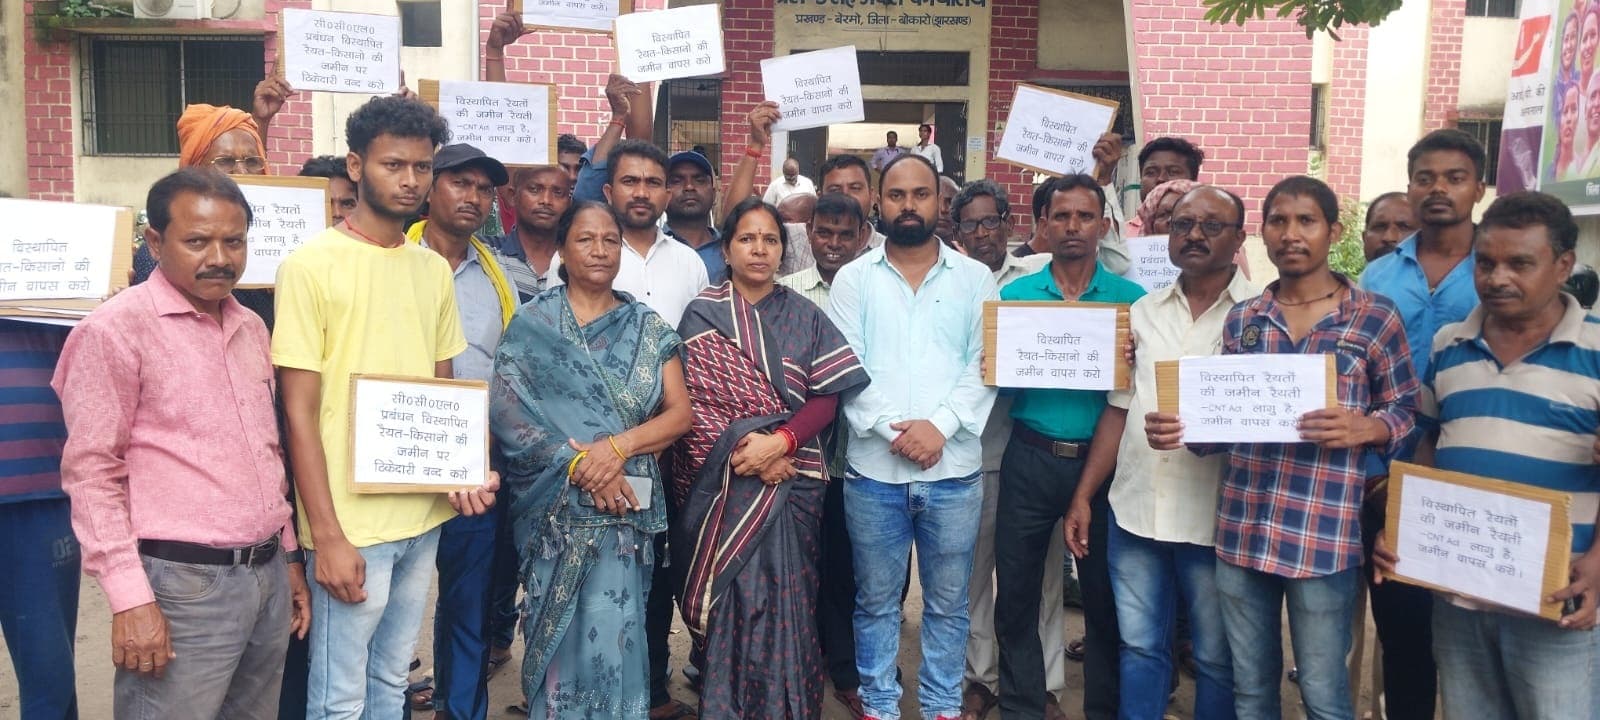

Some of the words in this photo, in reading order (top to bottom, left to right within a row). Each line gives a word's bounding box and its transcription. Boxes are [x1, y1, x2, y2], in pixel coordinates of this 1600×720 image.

[867, 12, 889, 25] जिला
[321, 61, 349, 72] जमीन
[356, 65, 368, 75] पर
[637, 60, 662, 72] जमीन
[669, 58, 690, 69] वापस
[455, 96, 499, 107] विस्थापित
[456, 108, 468, 118] की
[476, 109, 503, 119] जमीन
[782, 106, 806, 119] जमीन
[811, 104, 833, 115] वापस
[456, 133, 482, 142] जमीन
[1015, 143, 1039, 158] जमीन
[1043, 150, 1065, 164] वापस
[26, 280, 59, 292] वापस
[1037, 332, 1081, 345] विस्थापित
[1087, 349, 1099, 361] की
[1015, 364, 1044, 377] जमीन
[1050, 368, 1077, 379] वापस
[1082, 366, 1101, 379] करो
[1200, 371, 1255, 383] विस्थापित
[1200, 386, 1215, 397] की
[1224, 387, 1260, 398] जमीन
[1268, 386, 1301, 399] रैयती
[381, 408, 415, 423] प्रबंधन
[421, 411, 469, 429] विस्थापित
[1200, 416, 1232, 426] जमीन
[1240, 418, 1270, 427] वापस
[455, 433, 468, 447] की
[397, 445, 429, 459] जमीन
[436, 450, 450, 461] पर
[449, 466, 469, 480] करो
[1421, 496, 1477, 518] विस्थापित
[1420, 513, 1436, 526] की
[1444, 519, 1480, 536] जमीन
[1488, 526, 1522, 546] रैयती
[1418, 543, 1449, 559] जमीन
[1457, 553, 1488, 568] वापस
